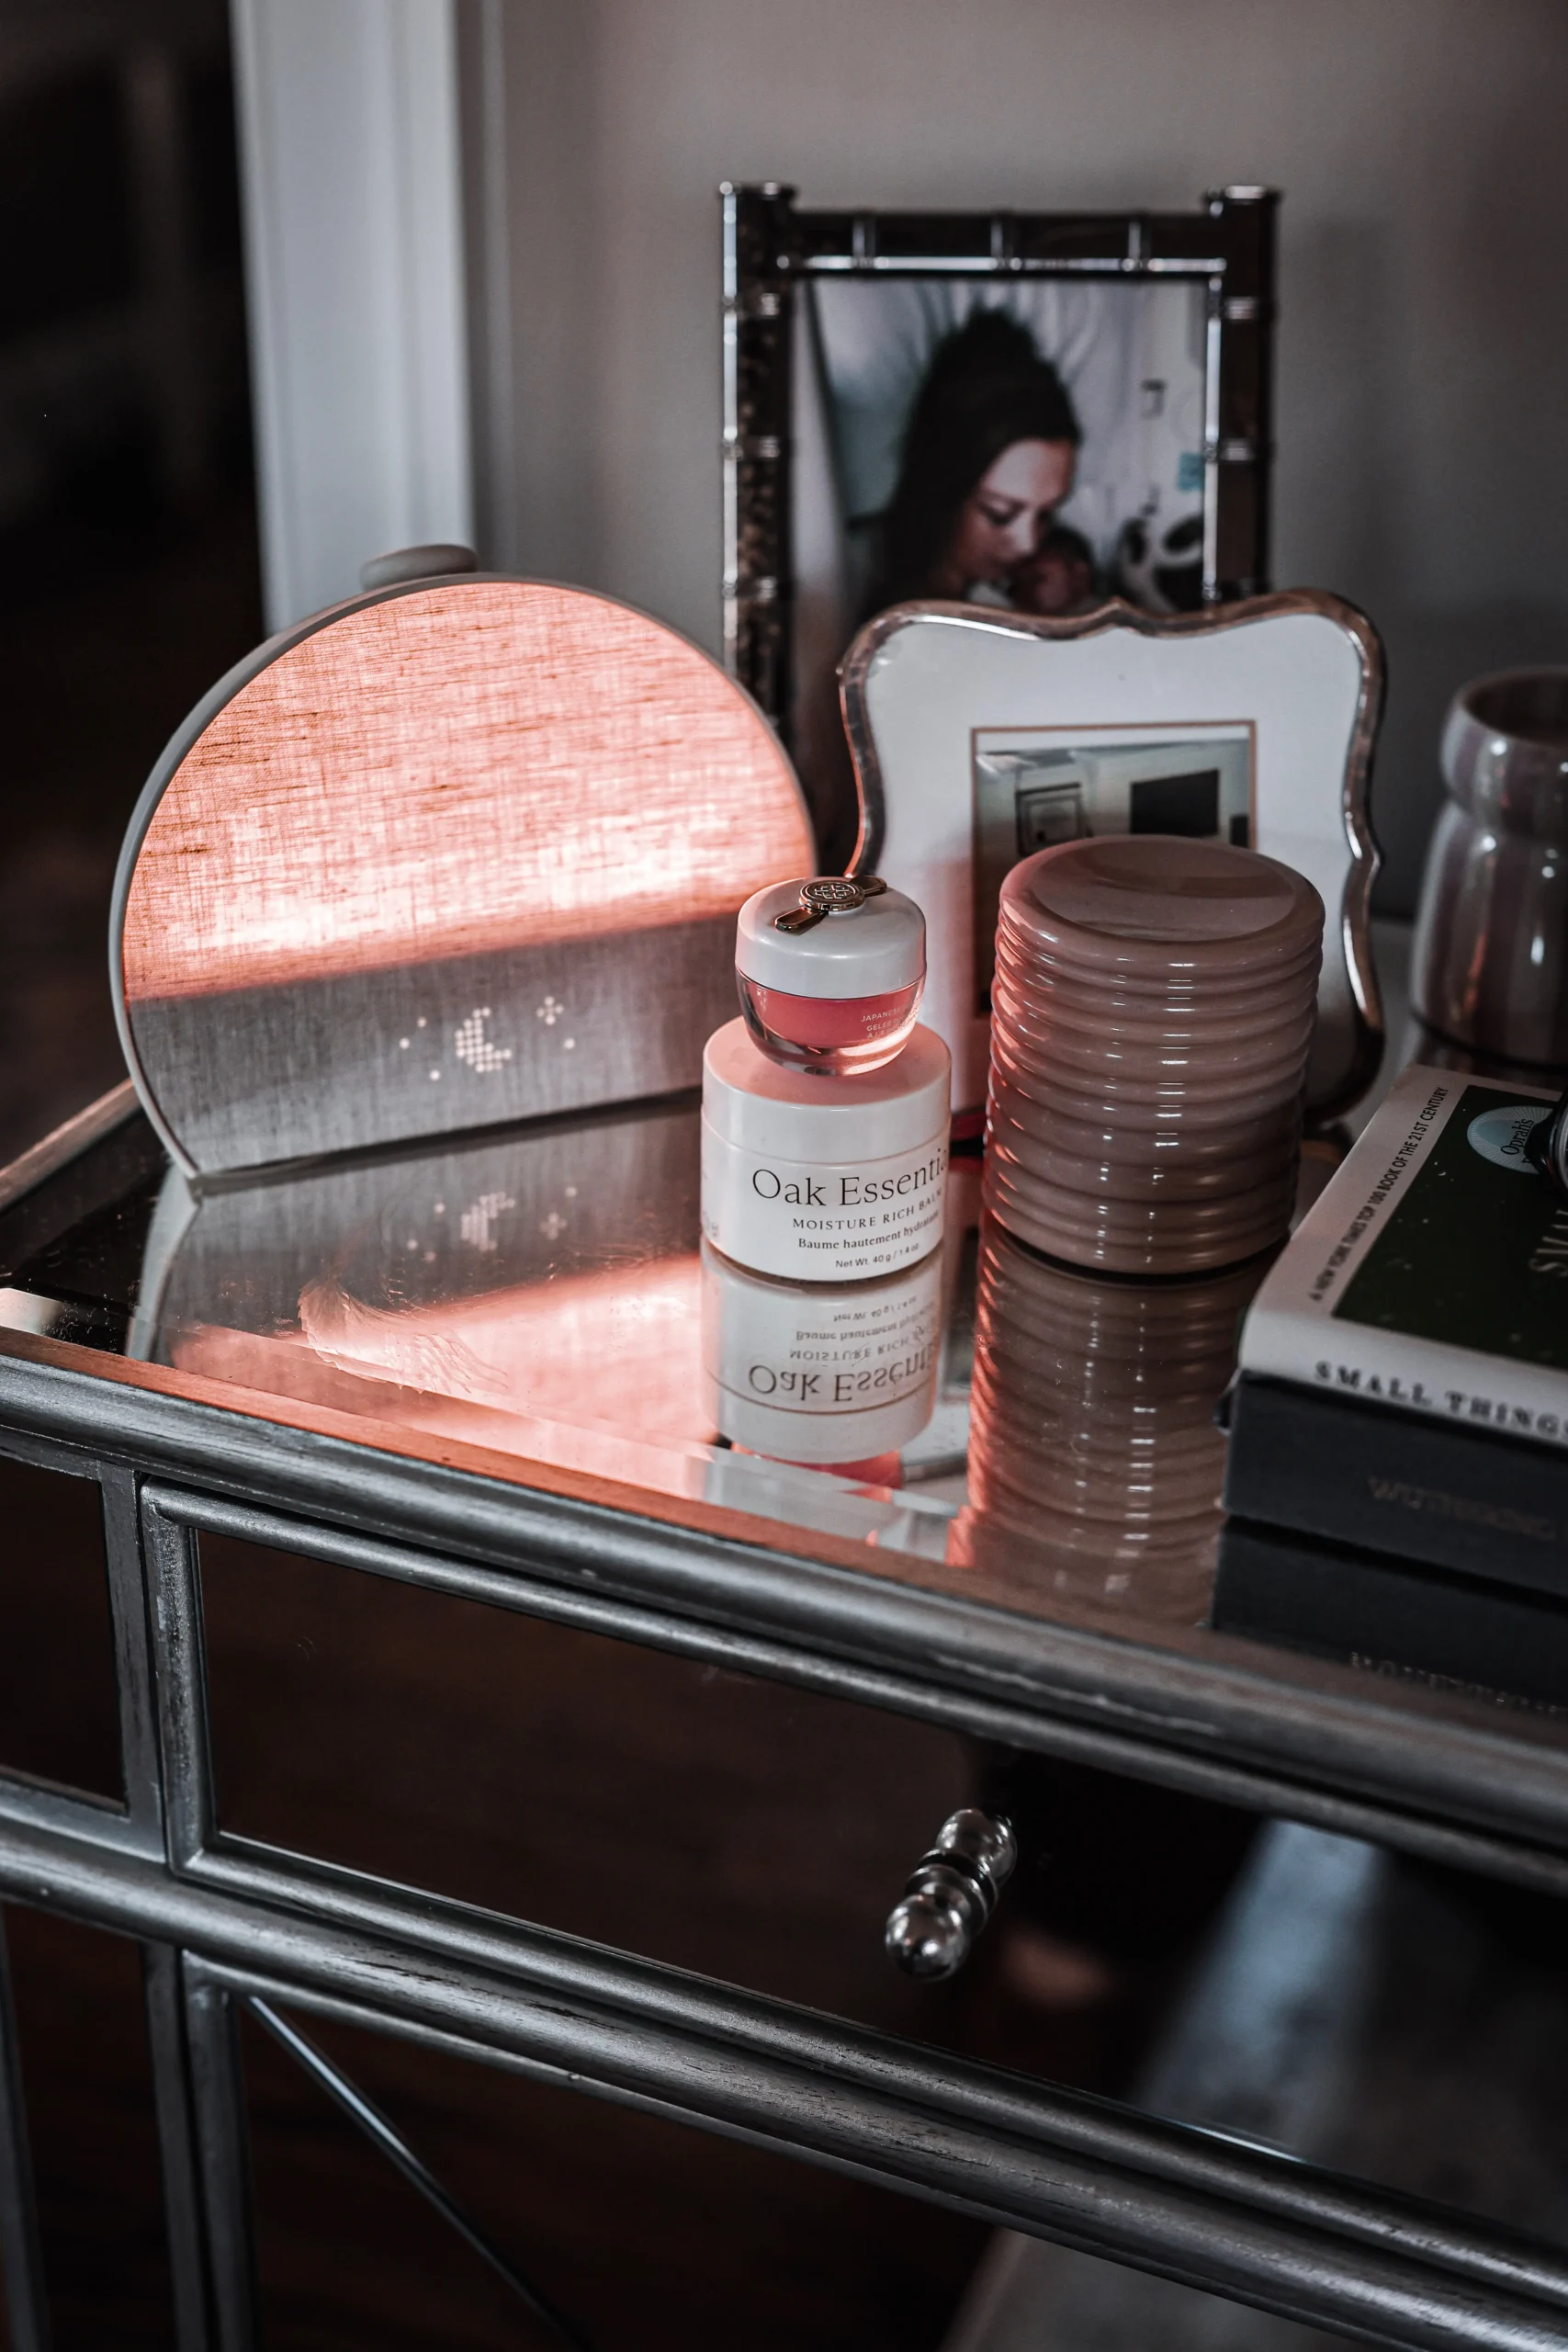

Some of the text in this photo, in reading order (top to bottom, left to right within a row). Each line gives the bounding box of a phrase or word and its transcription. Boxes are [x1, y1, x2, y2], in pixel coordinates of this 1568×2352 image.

[1419, 1086, 1450, 1121] CENTURY
[1407, 1121, 1429, 1142] 21ST
[1392, 1154, 1408, 1168] OF
[1398, 1140, 1419, 1161] THE
[752, 1169, 827, 1206] Oak
[1376, 1168, 1403, 1193] BOOK
[1367, 1185, 1387, 1205] 100
[793, 1216, 877, 1230] MOISTURE
[883, 1204, 915, 1224] RICH
[1356, 1205, 1376, 1222] TOP
[798, 1238, 840, 1250] Baume
[843, 1230, 901, 1249] hautement
[835, 1260, 852, 1268] Net
[873, 1254, 884, 1262] 40
[886, 1253, 891, 1262] g
[1314, 1360, 1432, 1406] SMALL
